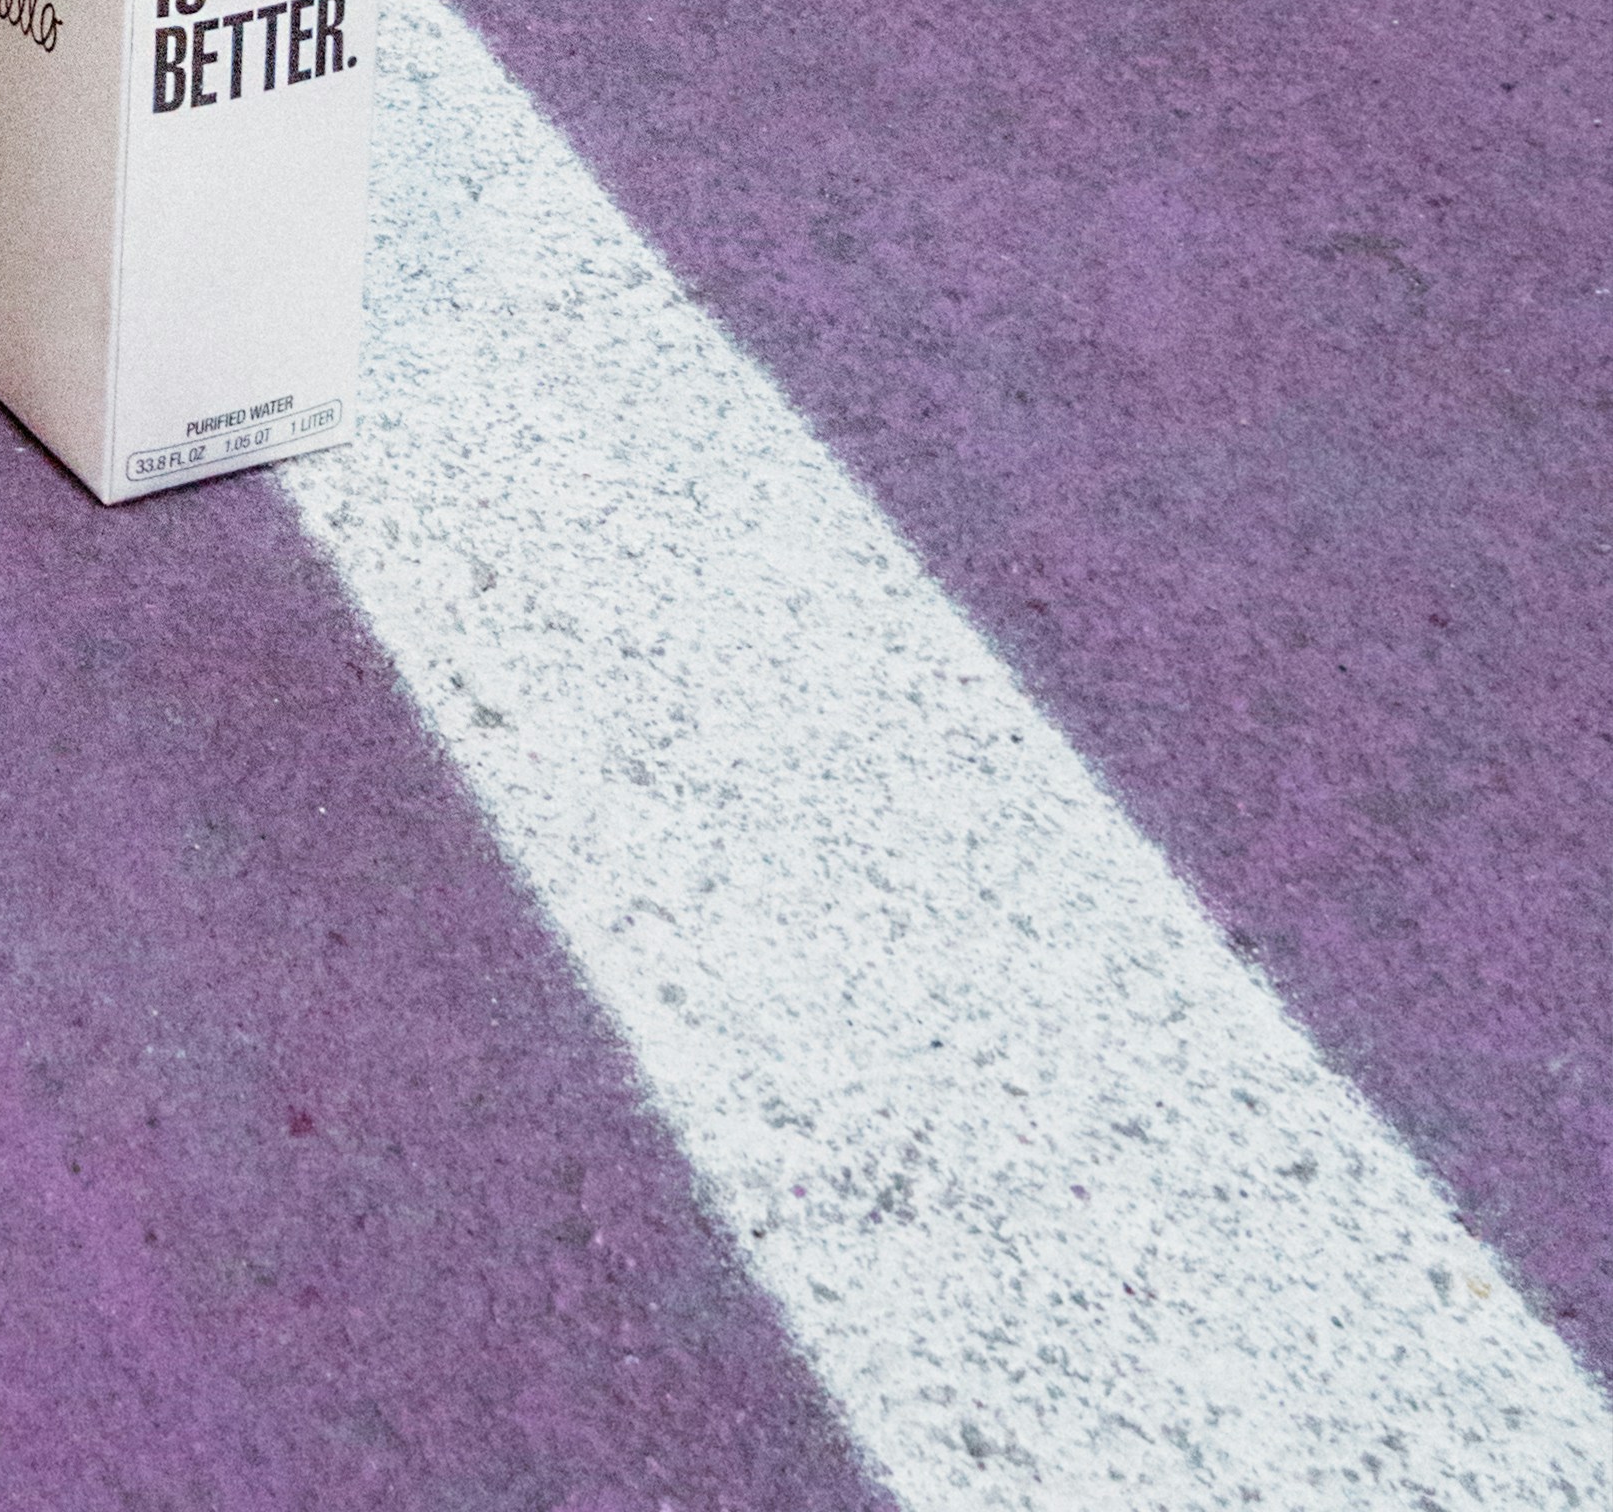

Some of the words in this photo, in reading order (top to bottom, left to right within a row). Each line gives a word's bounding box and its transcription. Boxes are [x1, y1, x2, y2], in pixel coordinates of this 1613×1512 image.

[135, 455, 167, 475] 33.8
[169, 449, 185, 468] FL
[188, 445, 206, 463] OZ
[225, 437, 251, 453] 1.05
[254, 428, 272, 445] QT
[300, 409, 334, 432] LITER
[186, 409, 246, 437] PURIFIED
[249, 395, 293, 421] WATER
